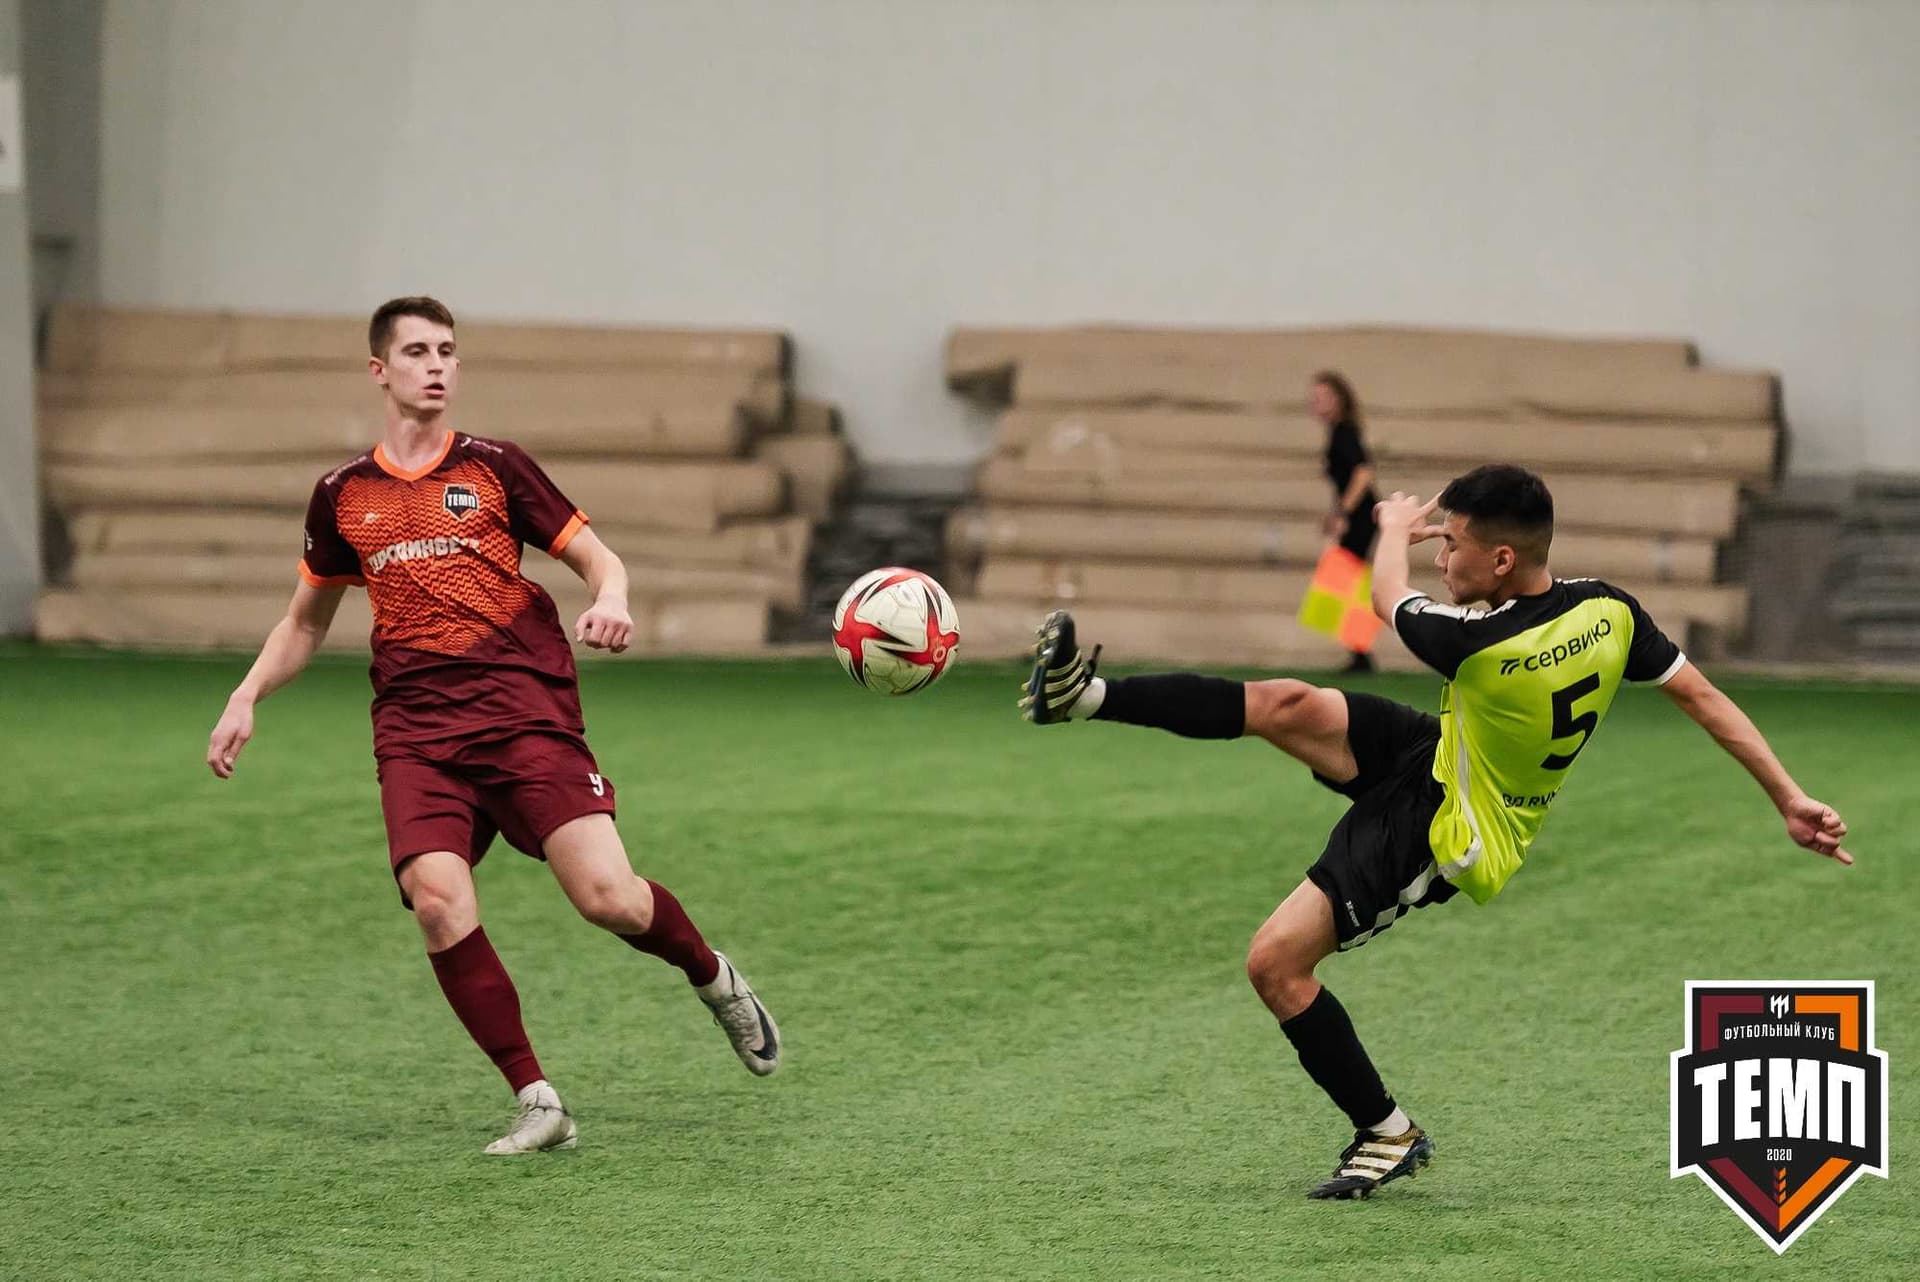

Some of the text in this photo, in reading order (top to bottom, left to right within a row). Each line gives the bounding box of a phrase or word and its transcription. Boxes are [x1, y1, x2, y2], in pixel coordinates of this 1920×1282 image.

[446, 494, 476, 508] ТЕМП
[1523, 618, 1611, 671] сервико
[1540, 672, 1600, 771] 5
